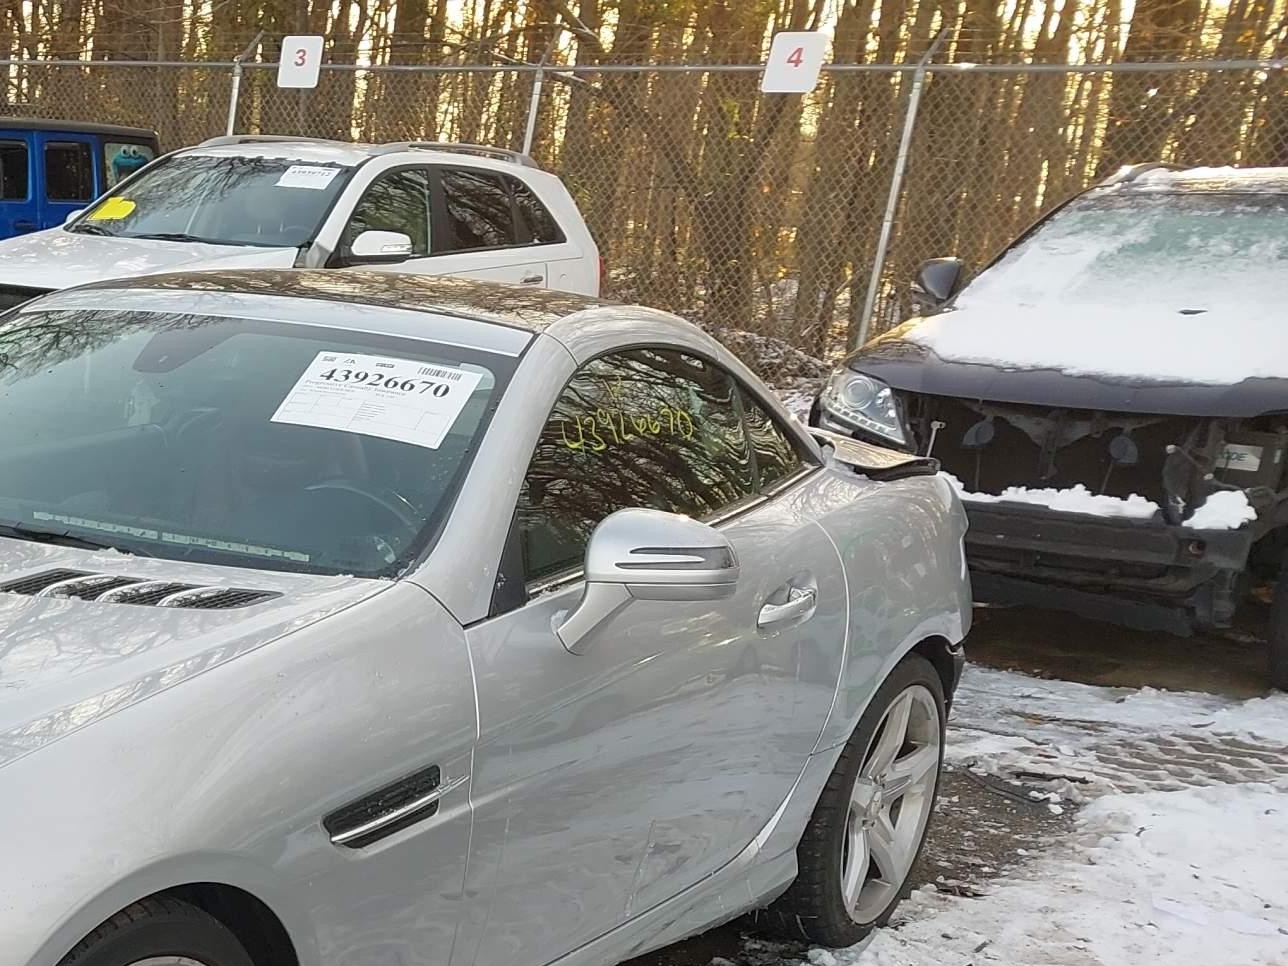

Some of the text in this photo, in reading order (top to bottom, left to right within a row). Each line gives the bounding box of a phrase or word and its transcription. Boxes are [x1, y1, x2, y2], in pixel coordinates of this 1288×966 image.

[294, 48, 307, 67] 3
[786, 47, 804, 68] 4
[319, 367, 450, 398] 43926670
